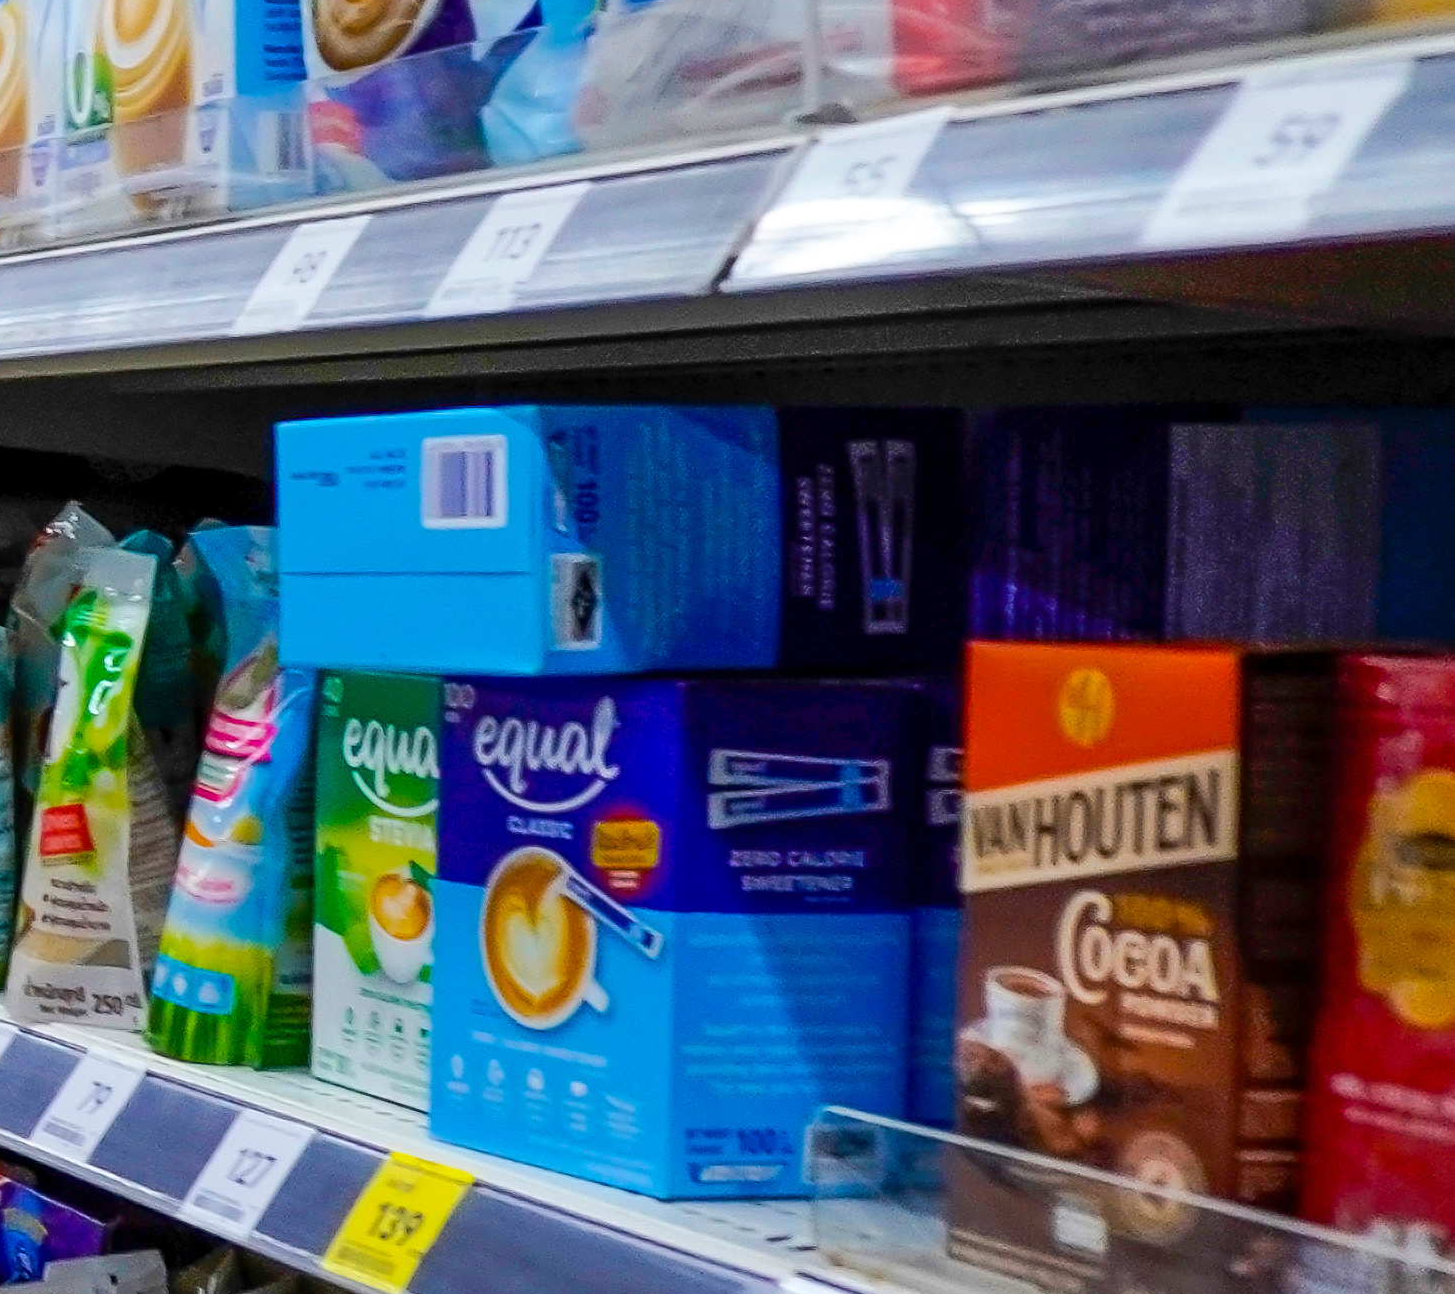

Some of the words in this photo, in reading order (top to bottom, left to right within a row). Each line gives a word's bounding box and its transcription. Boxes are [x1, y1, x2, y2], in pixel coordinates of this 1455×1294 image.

[342, 713, 437, 793] equa
[474, 697, 620, 793] equal
[968, 803, 1028, 862] VAN
[1037, 772, 1221, 854] HOUTEN
[233, 1147, 278, 1186] 127
[367, 1202, 424, 1246] 139
